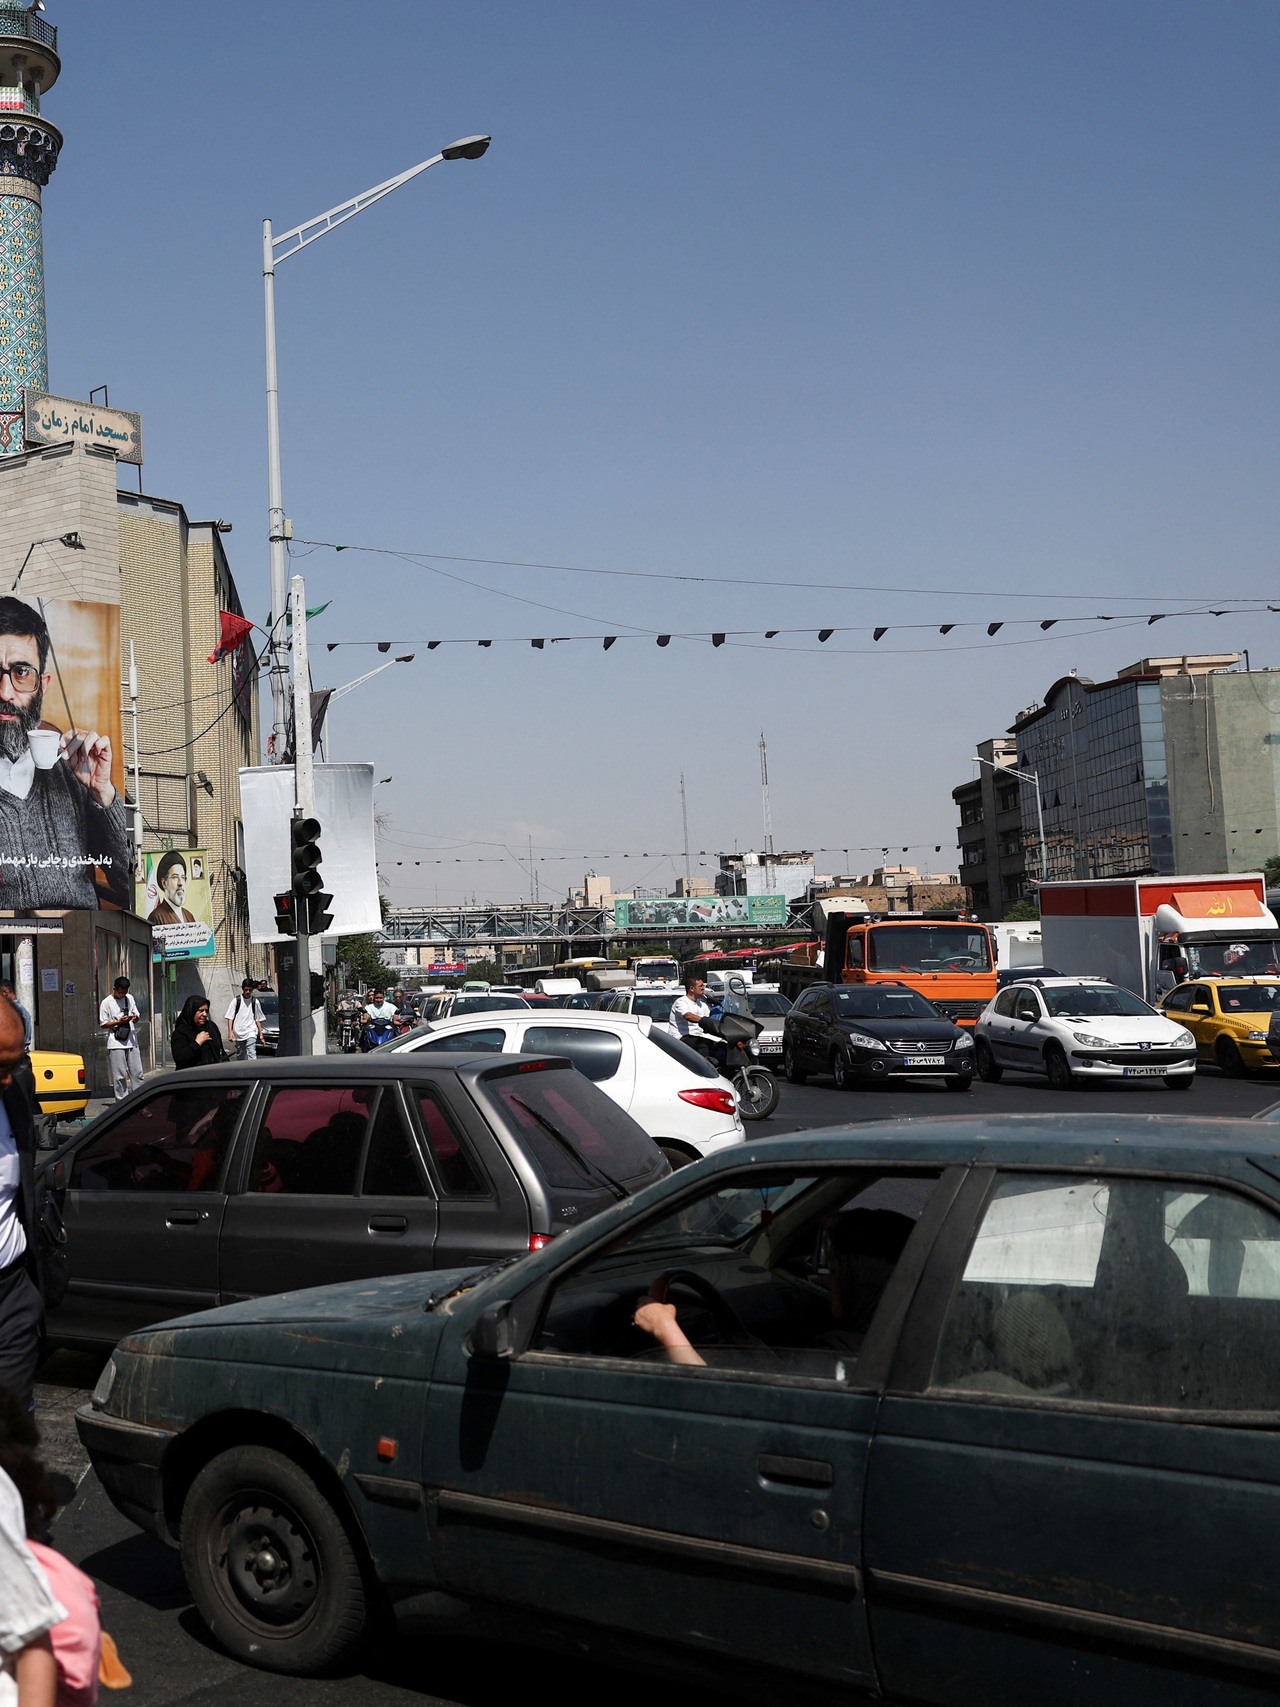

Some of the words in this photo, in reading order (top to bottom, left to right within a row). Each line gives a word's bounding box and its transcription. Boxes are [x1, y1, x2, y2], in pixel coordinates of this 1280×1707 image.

[42, 409, 69, 434] زمان
[71, 414, 94, 435] امام
[96, 423, 129, 443] مسجد
[25, 852, 38, 868] باز
[38, 853, 61, 870] چایی
[61, 857, 68, 868] و
[68, 853, 103, 868] لبخندی
[102, 855, 113, 868] به
[1205, 896, 1233, 915] الله
